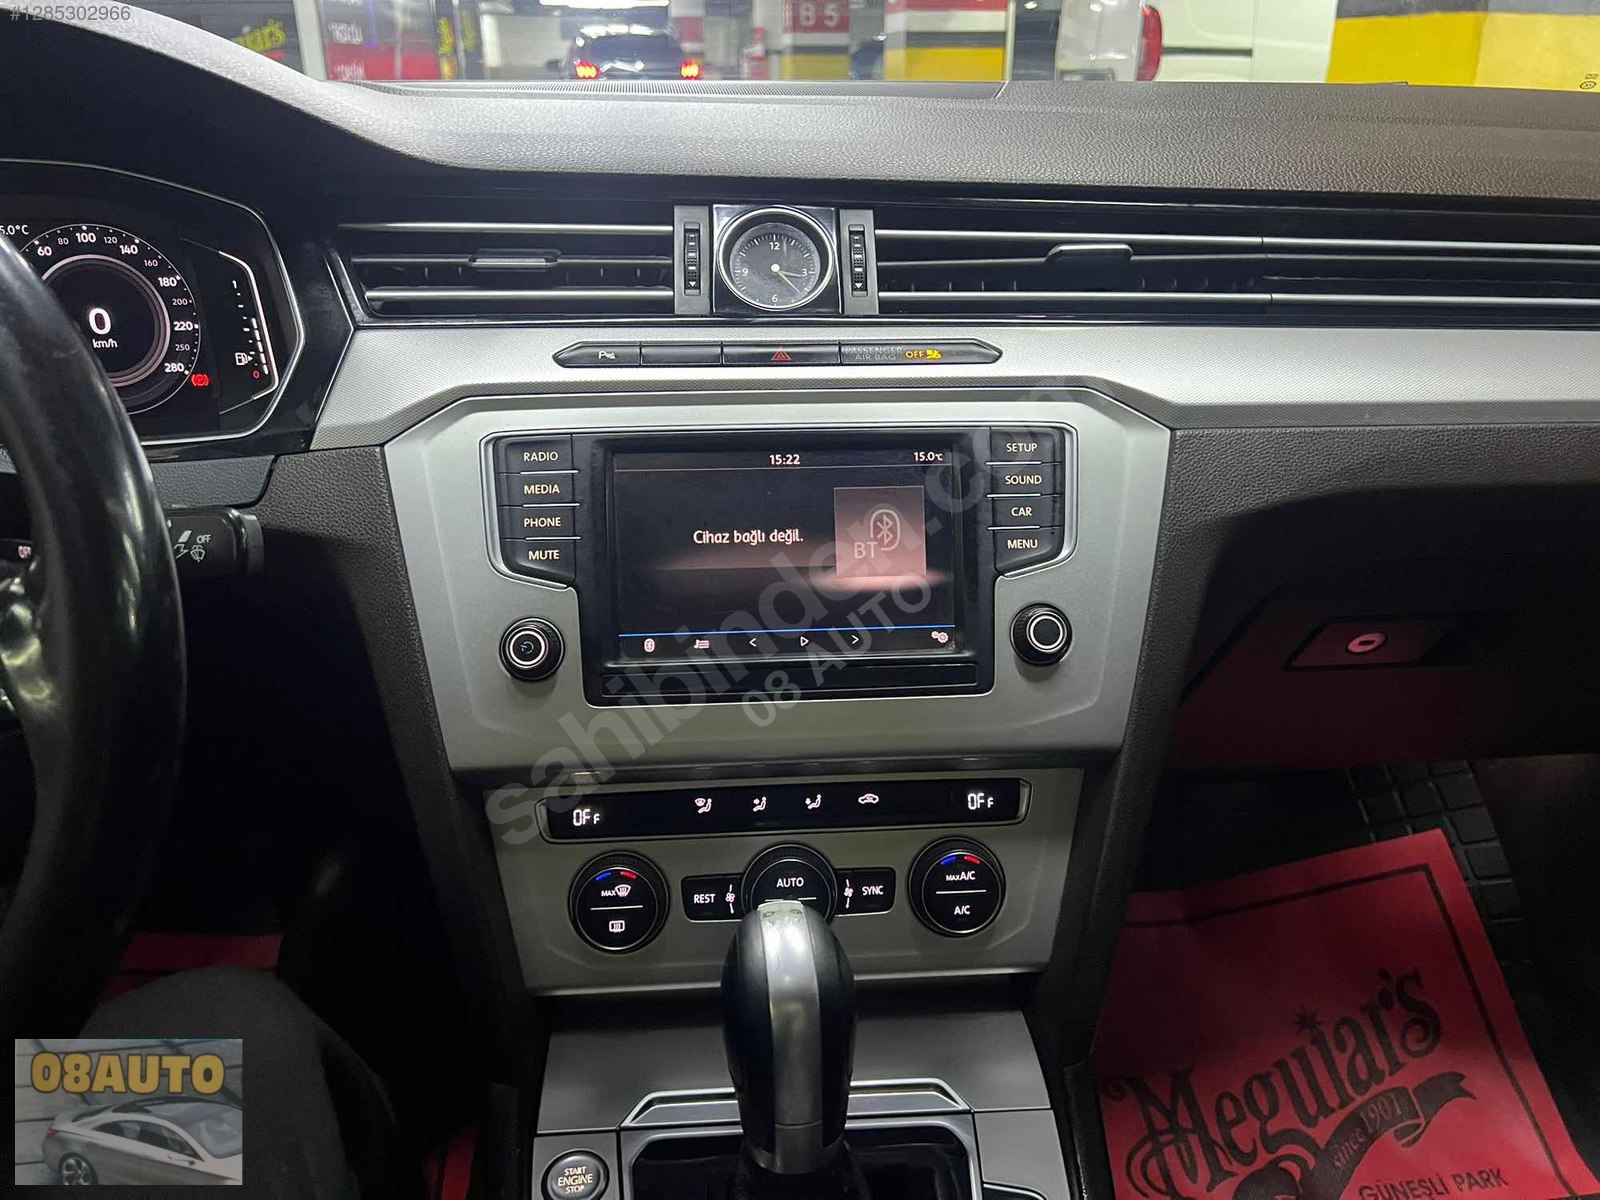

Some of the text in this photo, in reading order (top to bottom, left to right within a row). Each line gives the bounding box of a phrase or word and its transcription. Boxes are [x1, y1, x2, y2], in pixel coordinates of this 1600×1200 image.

[57, 237, 69, 245] 80
[75, 232, 97, 243] 100
[103, 236, 118, 244] 120
[37, 246, 52, 256] 60
[119, 245, 138, 255] 140
[769, 242, 781, 251] 12
[143, 258, 159, 267] 160
[742, 267, 749, 276] 9
[801, 268, 808, 277] 3
[157, 276, 178, 288] 180
[172, 298, 188, 306] 200
[771, 294, 778, 303] 6
[88, 307, 112, 335] 0
[173, 320, 194, 331] 220
[92, 338, 118, 350] km/h
[174, 343, 190, 352] 250
[905, 350, 924, 359] OFF
[164, 362, 185, 373] 280
[1005, 442, 1038, 453] SETUP
[523, 451, 559, 463] RADIO
[769, 453, 801, 466] 15:22
[1005, 474, 1042, 485] SOUND
[523, 483, 561, 495] MEDIA
[1011, 506, 1032, 517] CAR
[523, 516, 562, 528] PHONE
[196, 534, 212, 544] OFF
[693, 528, 804, 546] Cihaz bağlı değil.
[1007, 538, 1039, 550] MENU
[528, 549, 561, 561] MUTE
[854, 541, 878, 560] BT
[776, 877, 805, 888] AUTO
[600, 889, 617, 897] MAX
[861, 885, 884, 896] SYNC
[693, 893, 716, 905] REST
[953, 904, 971, 916] A/C
[1106, 966, 1442, 1199] Meguiar's
[1362, 1093, 1403, 1136] 1901
[564, 1166, 587, 1176] START
[557, 1173, 593, 1187] ENGINE
[1452, 1167, 1510, 1192] PARK
[565, 1184, 586, 1194] STOP
